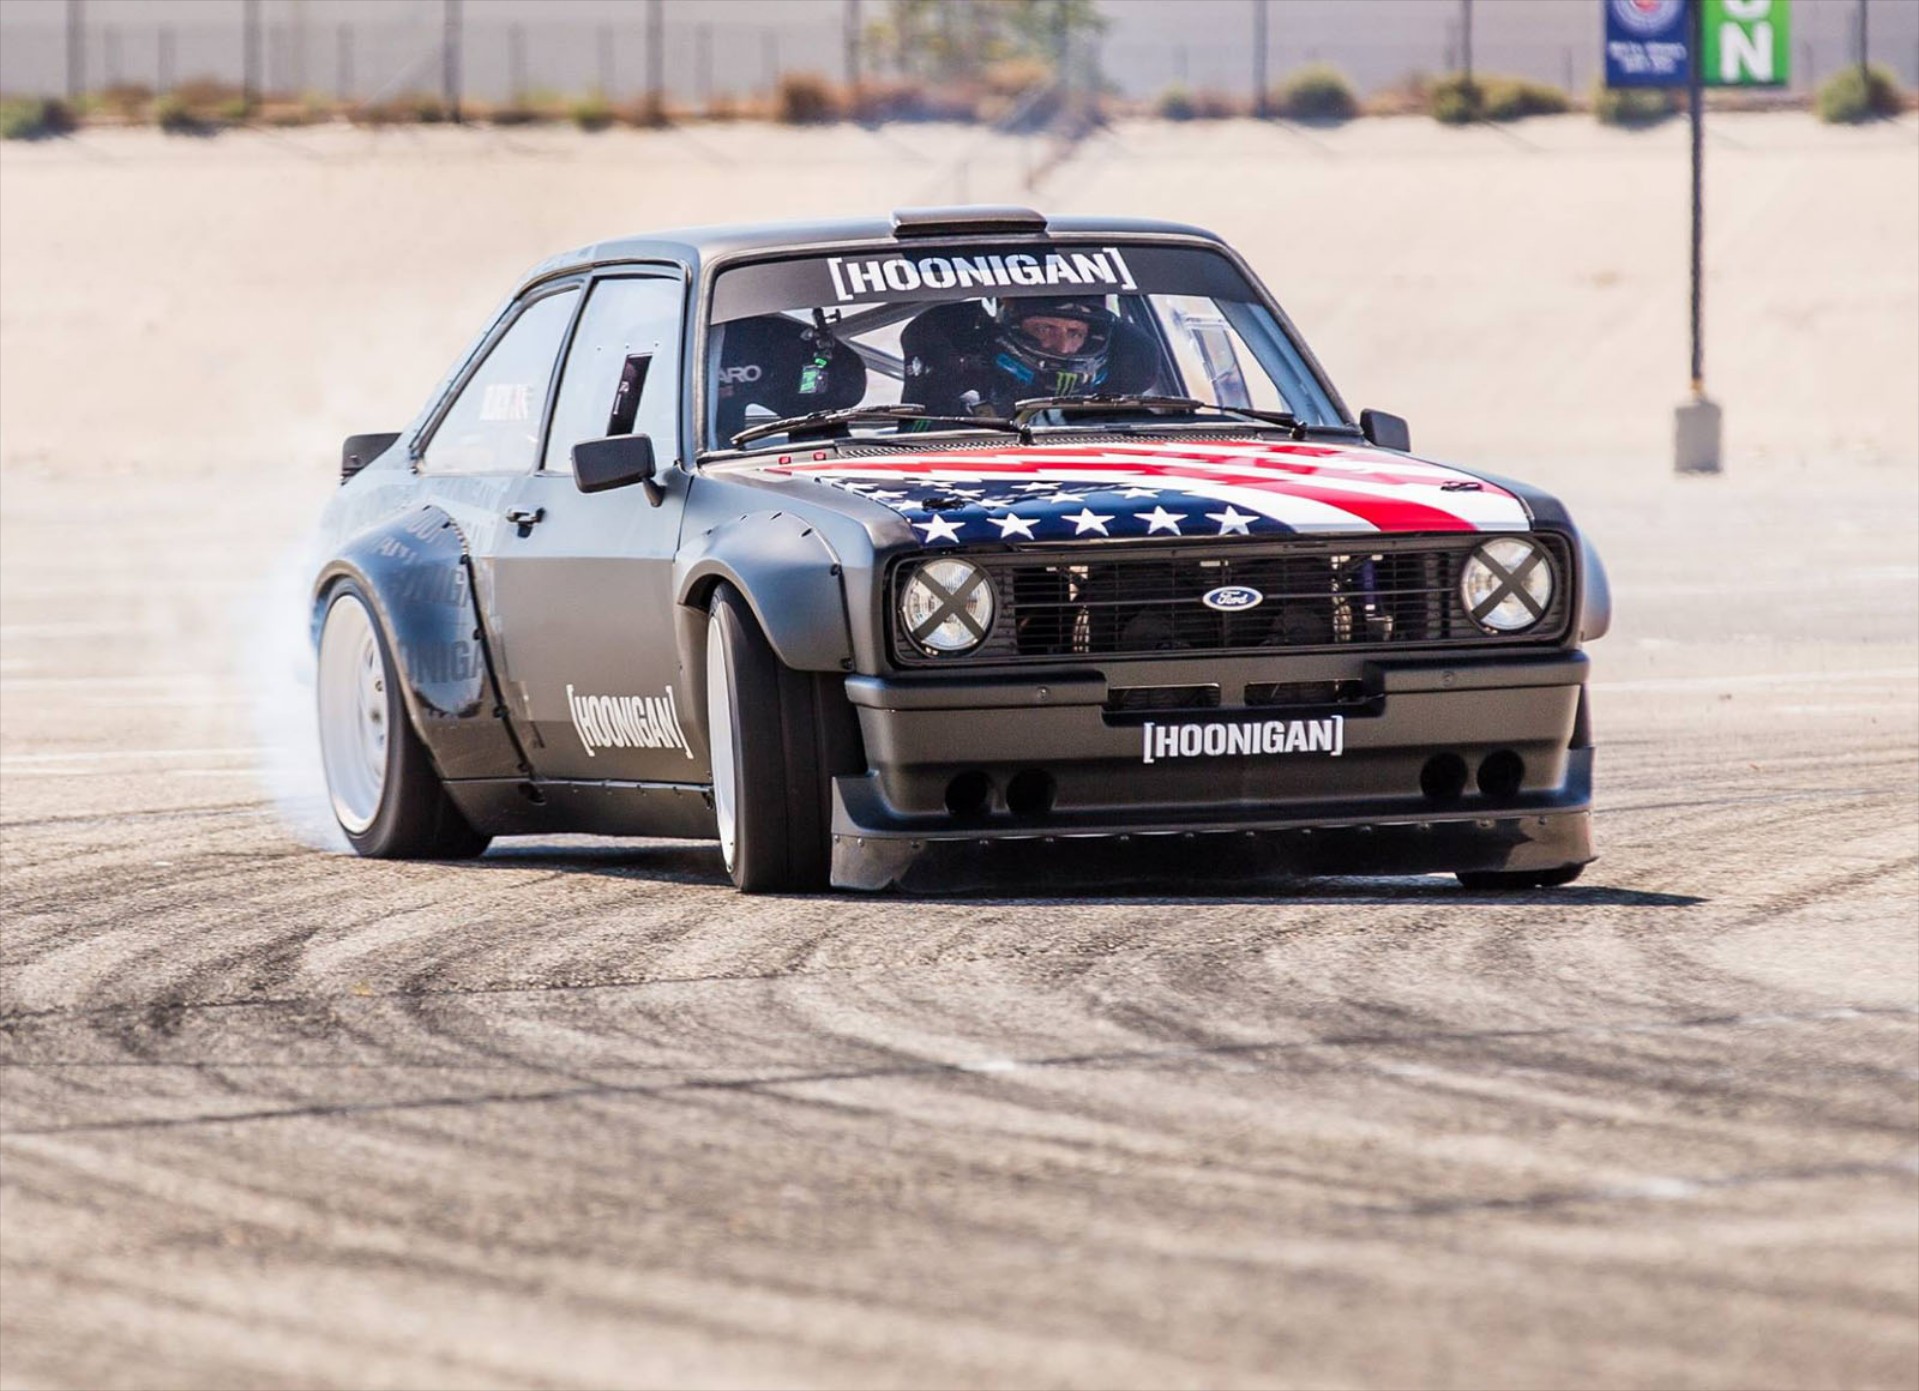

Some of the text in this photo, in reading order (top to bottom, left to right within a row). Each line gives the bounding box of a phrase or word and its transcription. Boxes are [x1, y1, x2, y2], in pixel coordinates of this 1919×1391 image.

[827, 247, 1138, 301] [HOONIGAN]
[1217, 590, 1248, 605] Ford
[566, 684, 694, 759] [HOONIGAN]
[1143, 715, 1344, 764] [HOONIGAN]
